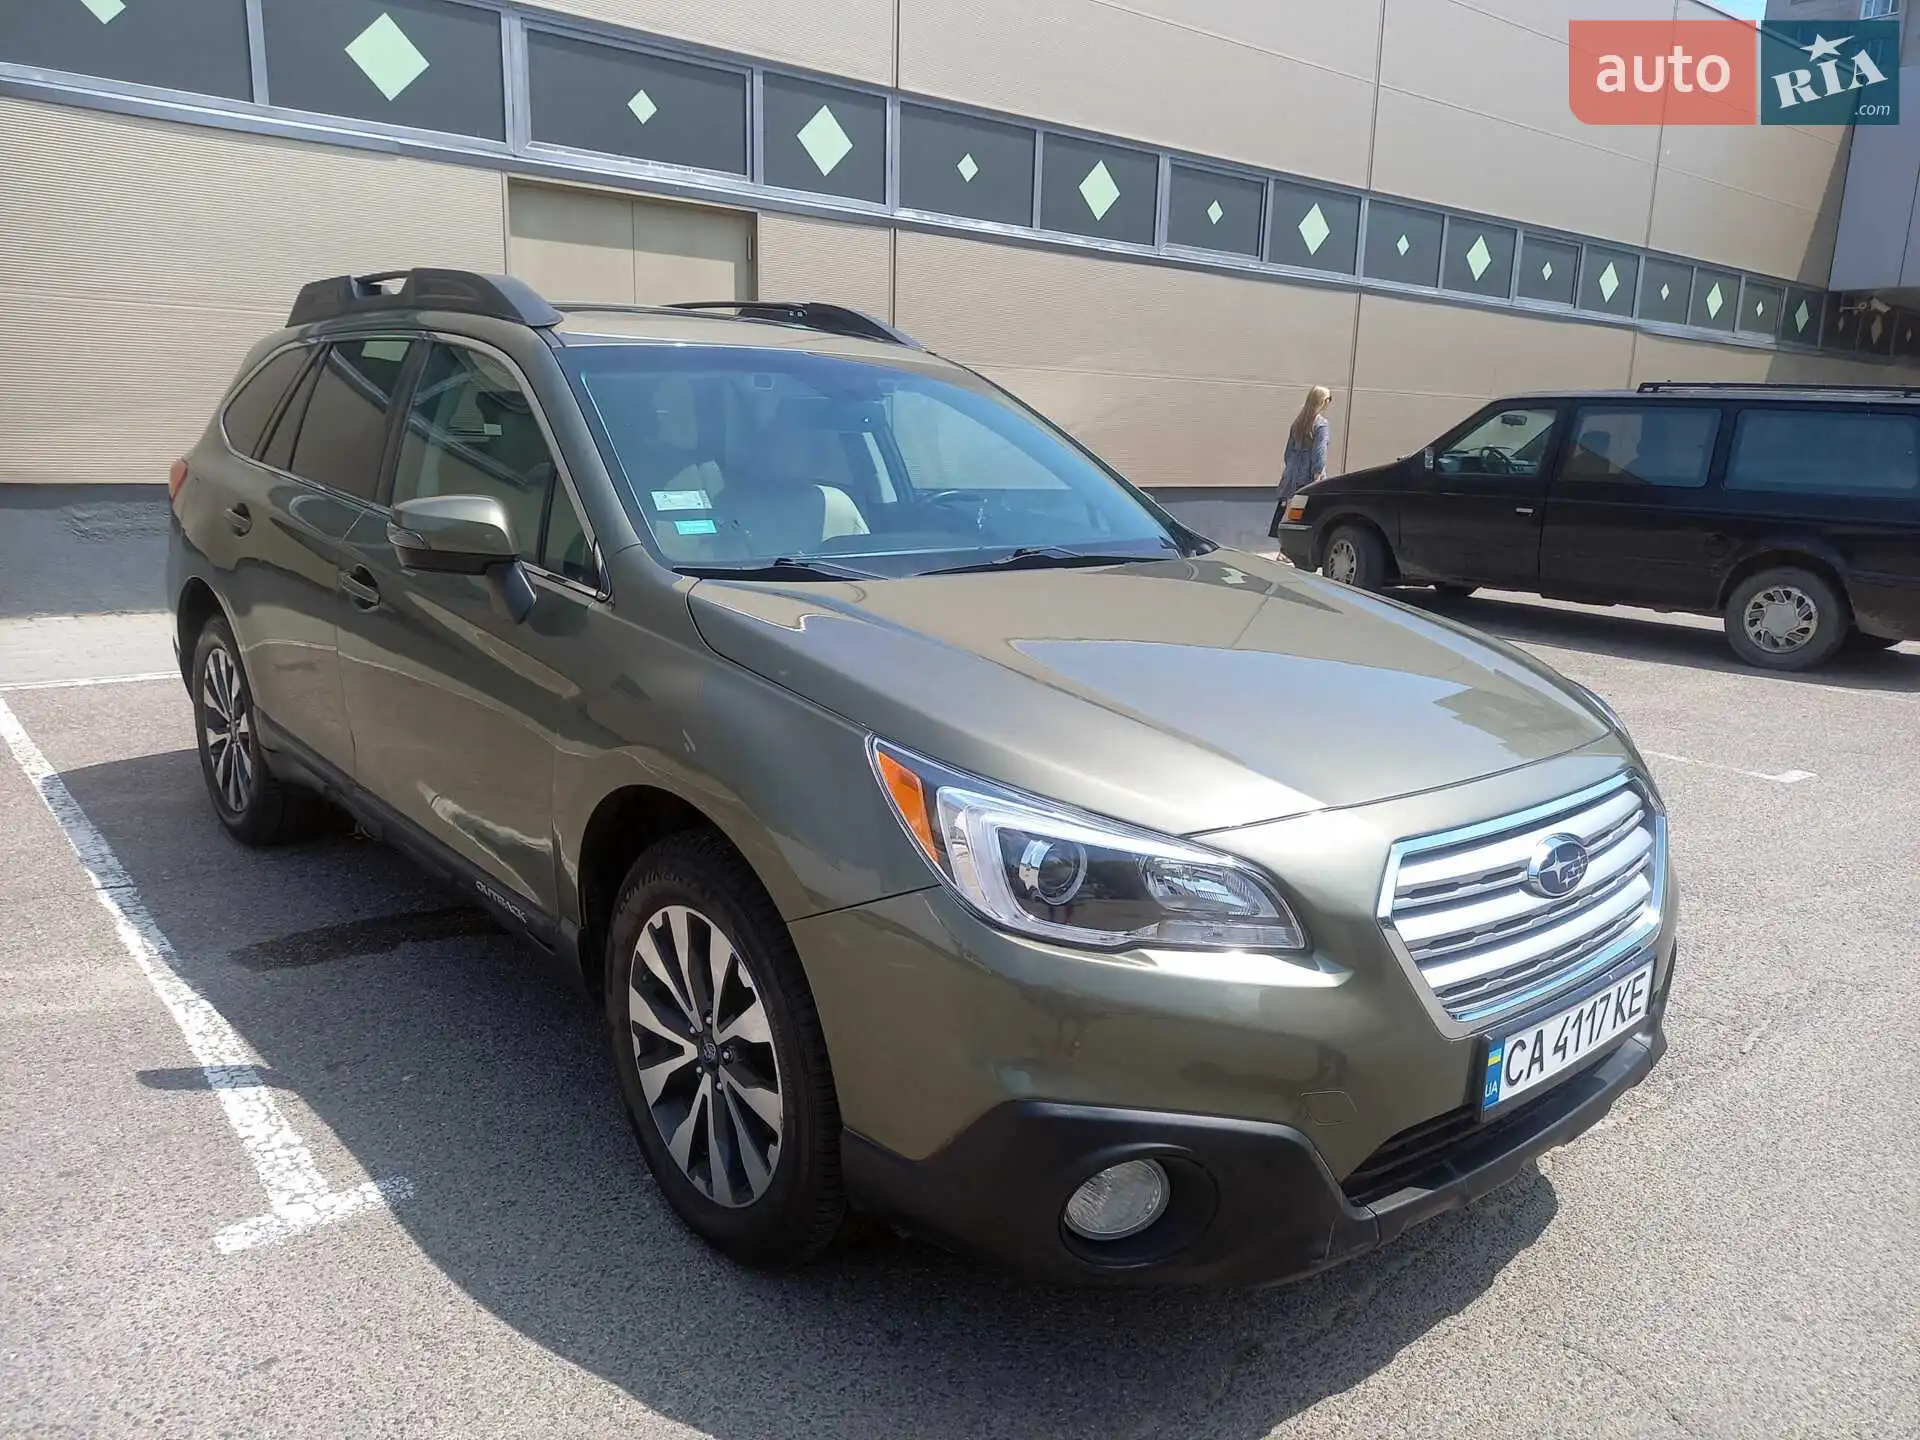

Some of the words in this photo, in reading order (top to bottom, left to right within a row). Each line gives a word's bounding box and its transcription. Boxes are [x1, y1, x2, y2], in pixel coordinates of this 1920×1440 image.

[1505, 1029, 1544, 1087] CA
[1552, 996, 1612, 1062] 4117
[1611, 970, 1647, 1031] KE
[1484, 1081, 1498, 1097] UA
